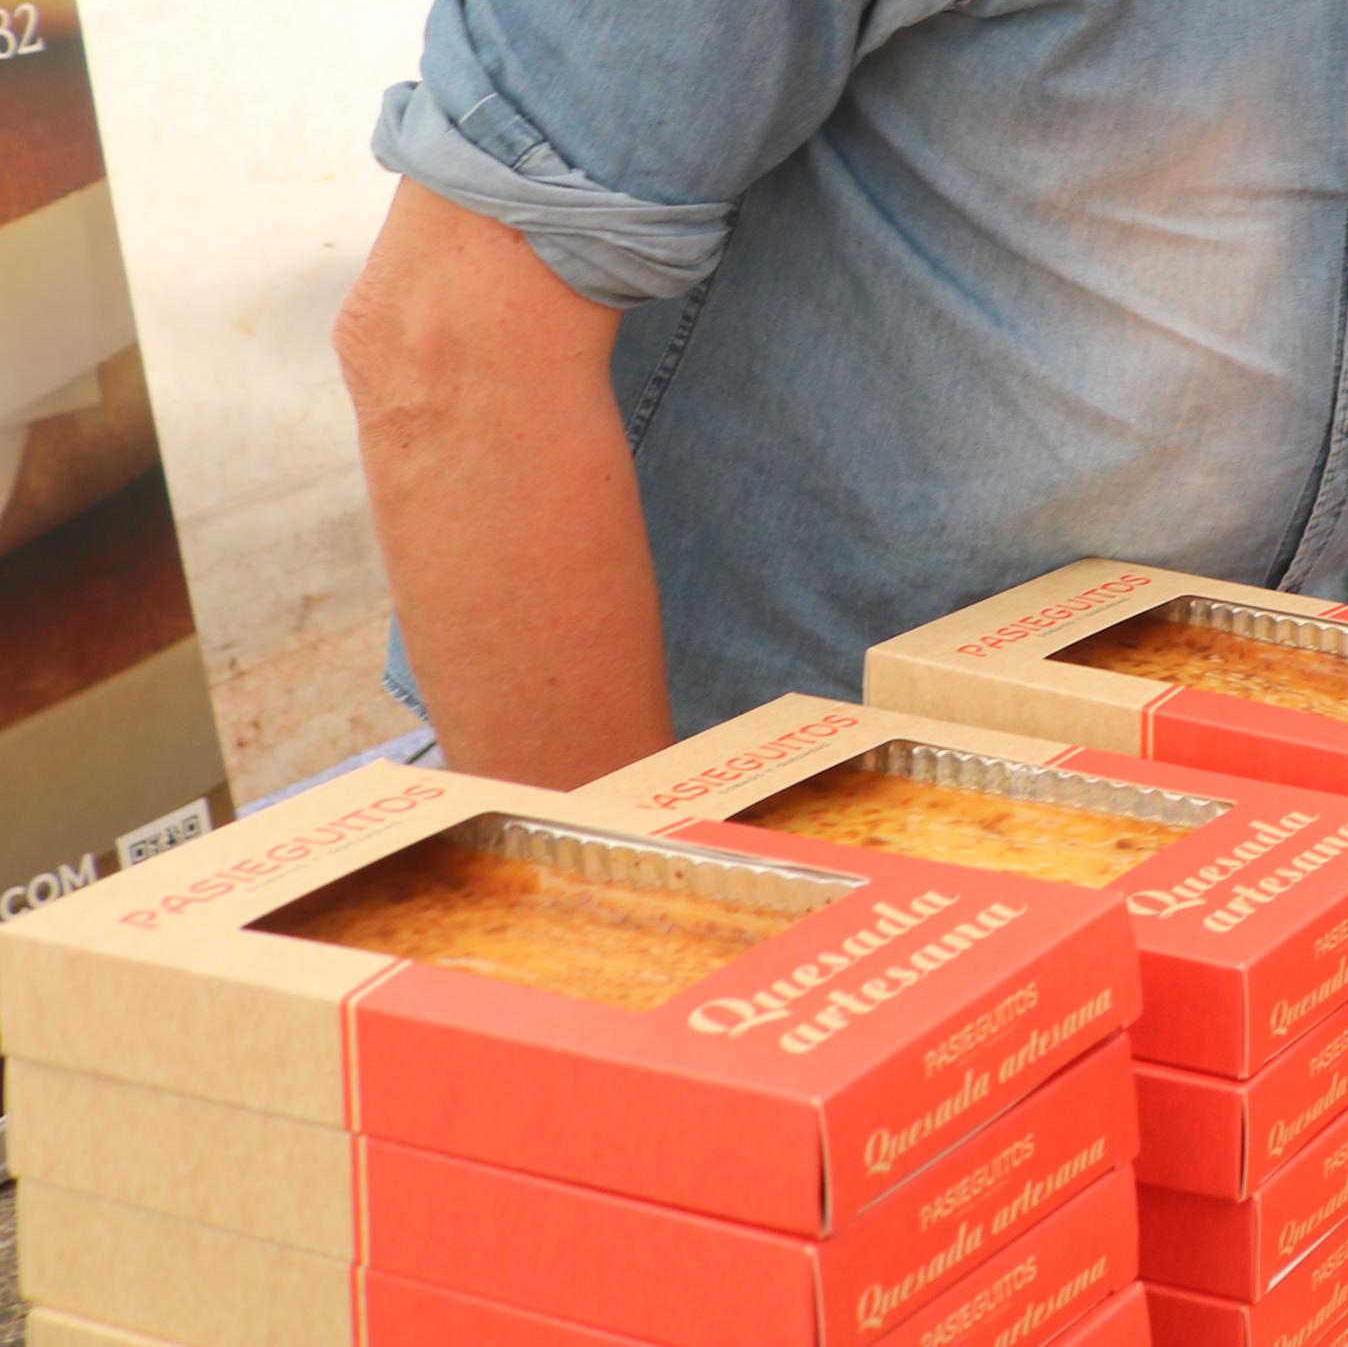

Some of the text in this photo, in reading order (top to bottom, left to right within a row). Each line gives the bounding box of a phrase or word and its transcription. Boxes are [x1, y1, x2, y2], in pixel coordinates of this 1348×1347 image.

[956, 573, 1152, 658] PASIEGUITOS
[118, 784, 447, 930] PASIEGUITOS
[1127, 809, 1320, 920] Quesada
[688, 888, 961, 1039] Quesada
[778, 901, 1028, 1054] artesana
[863, 987, 1113, 1177] Quesada artesana
[924, 981, 1039, 1078] PASIEGUITOS
[1268, 1075, 1348, 1156] Quesada
[856, 1136, 1106, 1332] Quesada artesana
[920, 1132, 1037, 1231] PASIEGUITOS
[920, 1255, 1038, 1347] PASIEGUITOS
[993, 1255, 1107, 1347] artesana
